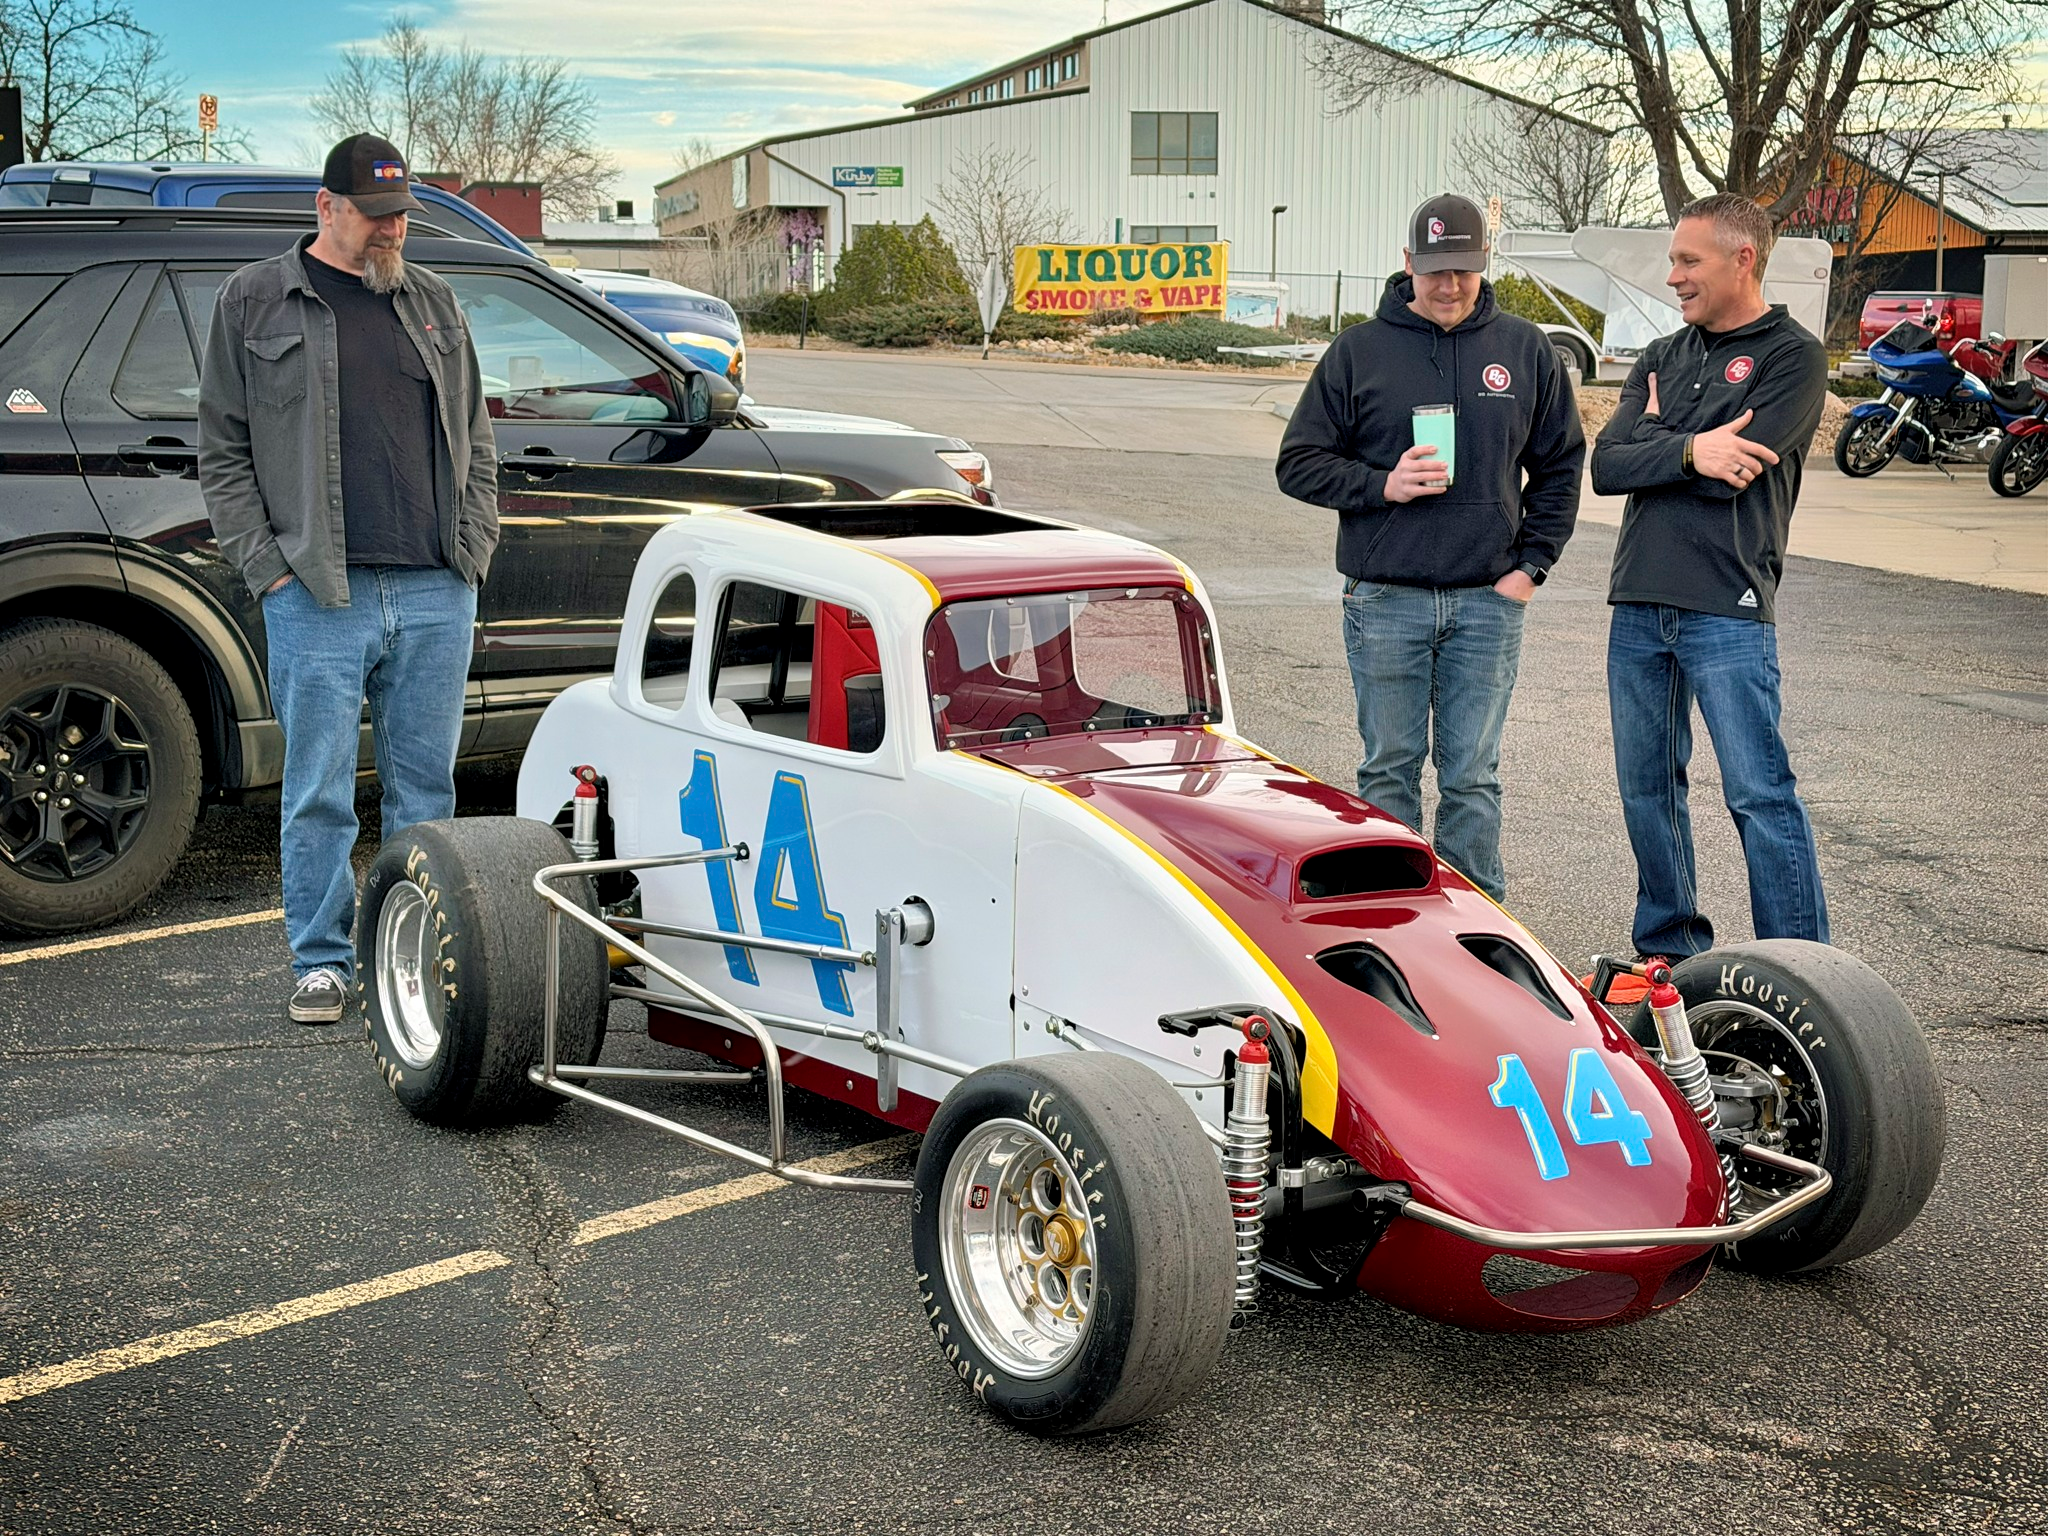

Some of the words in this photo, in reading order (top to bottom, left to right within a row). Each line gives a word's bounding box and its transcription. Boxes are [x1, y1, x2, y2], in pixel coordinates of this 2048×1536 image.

[836, 169, 874, 185] Kirby
[1025, 289, 1126, 310] SMOKE
[1134, 288, 1152, 307] &
[1160, 284, 1223, 307] VAPE
[1038, 245, 1212, 281] LIQUOR
[1488, 369, 1506, 386] BG
[403, 844, 460, 1000] Hoosier
[679, 748, 855, 1017] 14
[1715, 963, 1827, 1051] Hoosier
[1023, 1089, 1108, 1230] Hoosier
[1488, 1047, 1654, 1181] 14
[917, 1272, 997, 1404] Hoosier
